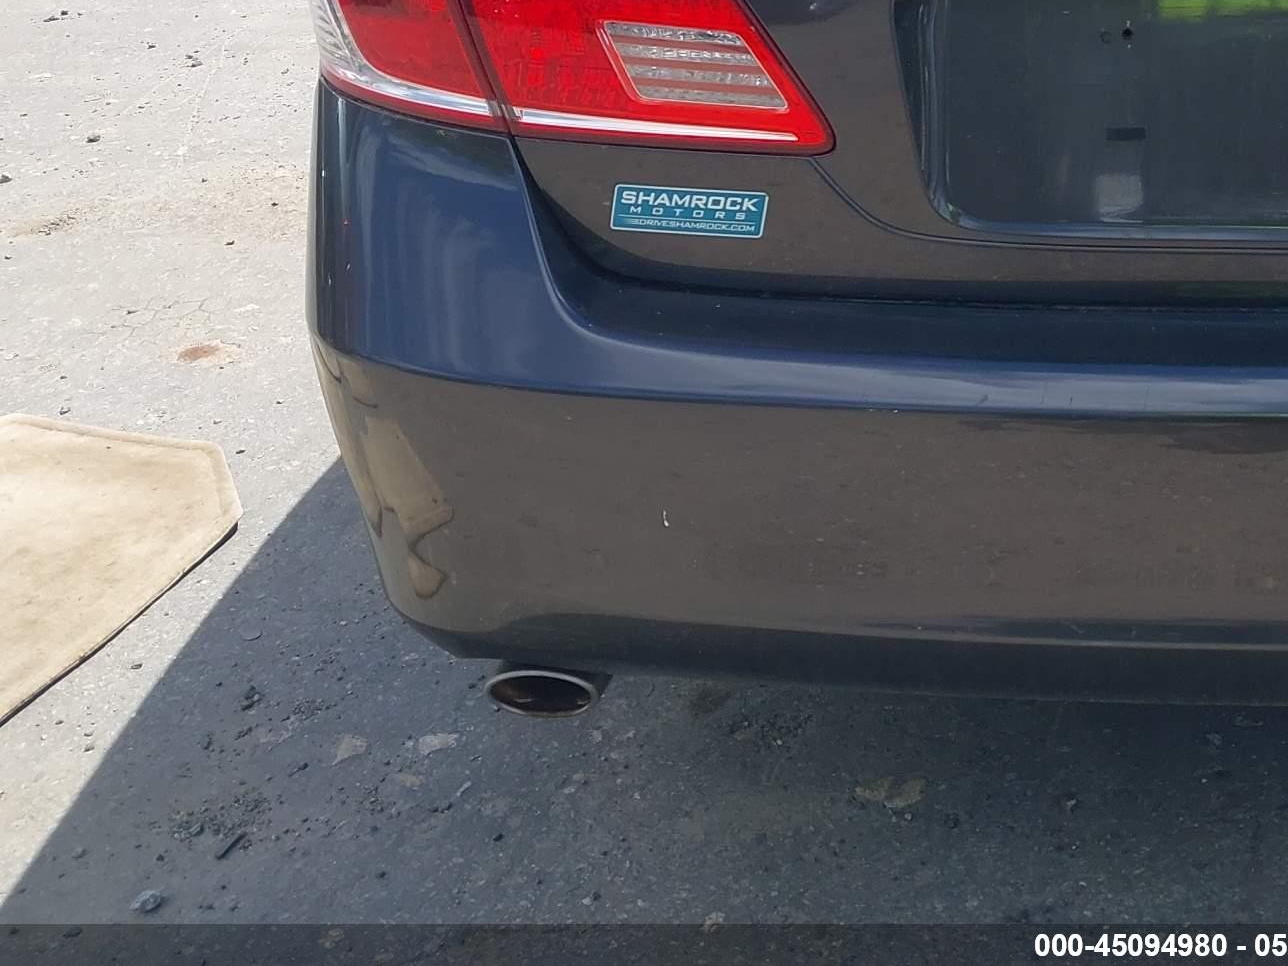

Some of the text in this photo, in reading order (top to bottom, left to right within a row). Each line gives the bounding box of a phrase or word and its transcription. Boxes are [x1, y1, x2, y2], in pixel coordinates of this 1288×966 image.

[621, 191, 758, 211] SHAMROCK
[629, 206, 747, 219] MOTORS
[638, 220, 755, 232] DRIVESHAMROCK.COM
